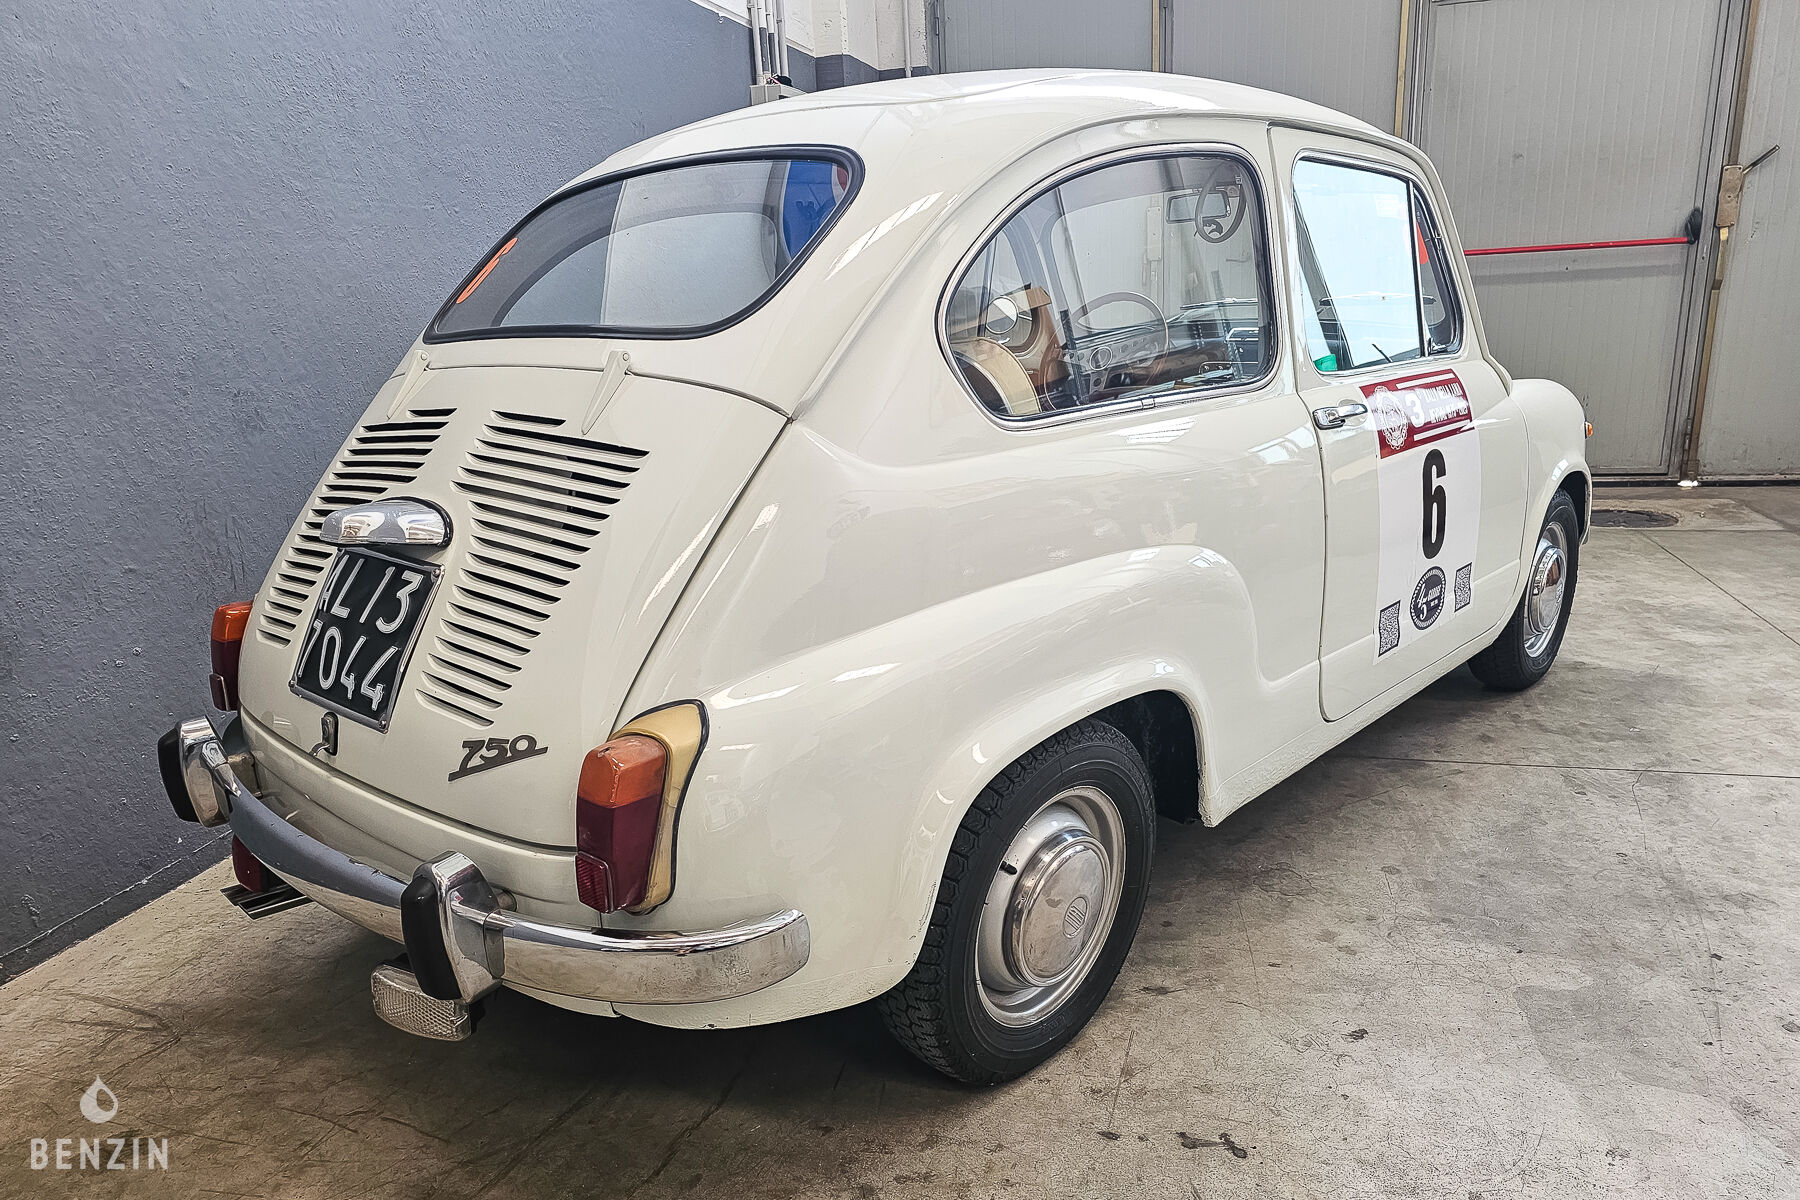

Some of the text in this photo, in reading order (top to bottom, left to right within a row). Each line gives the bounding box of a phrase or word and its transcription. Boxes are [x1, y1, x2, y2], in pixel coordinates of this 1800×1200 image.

[1423, 449, 1446, 559] 6
[298, 618, 399, 711] 7044
[456, 734, 540, 774] 750
